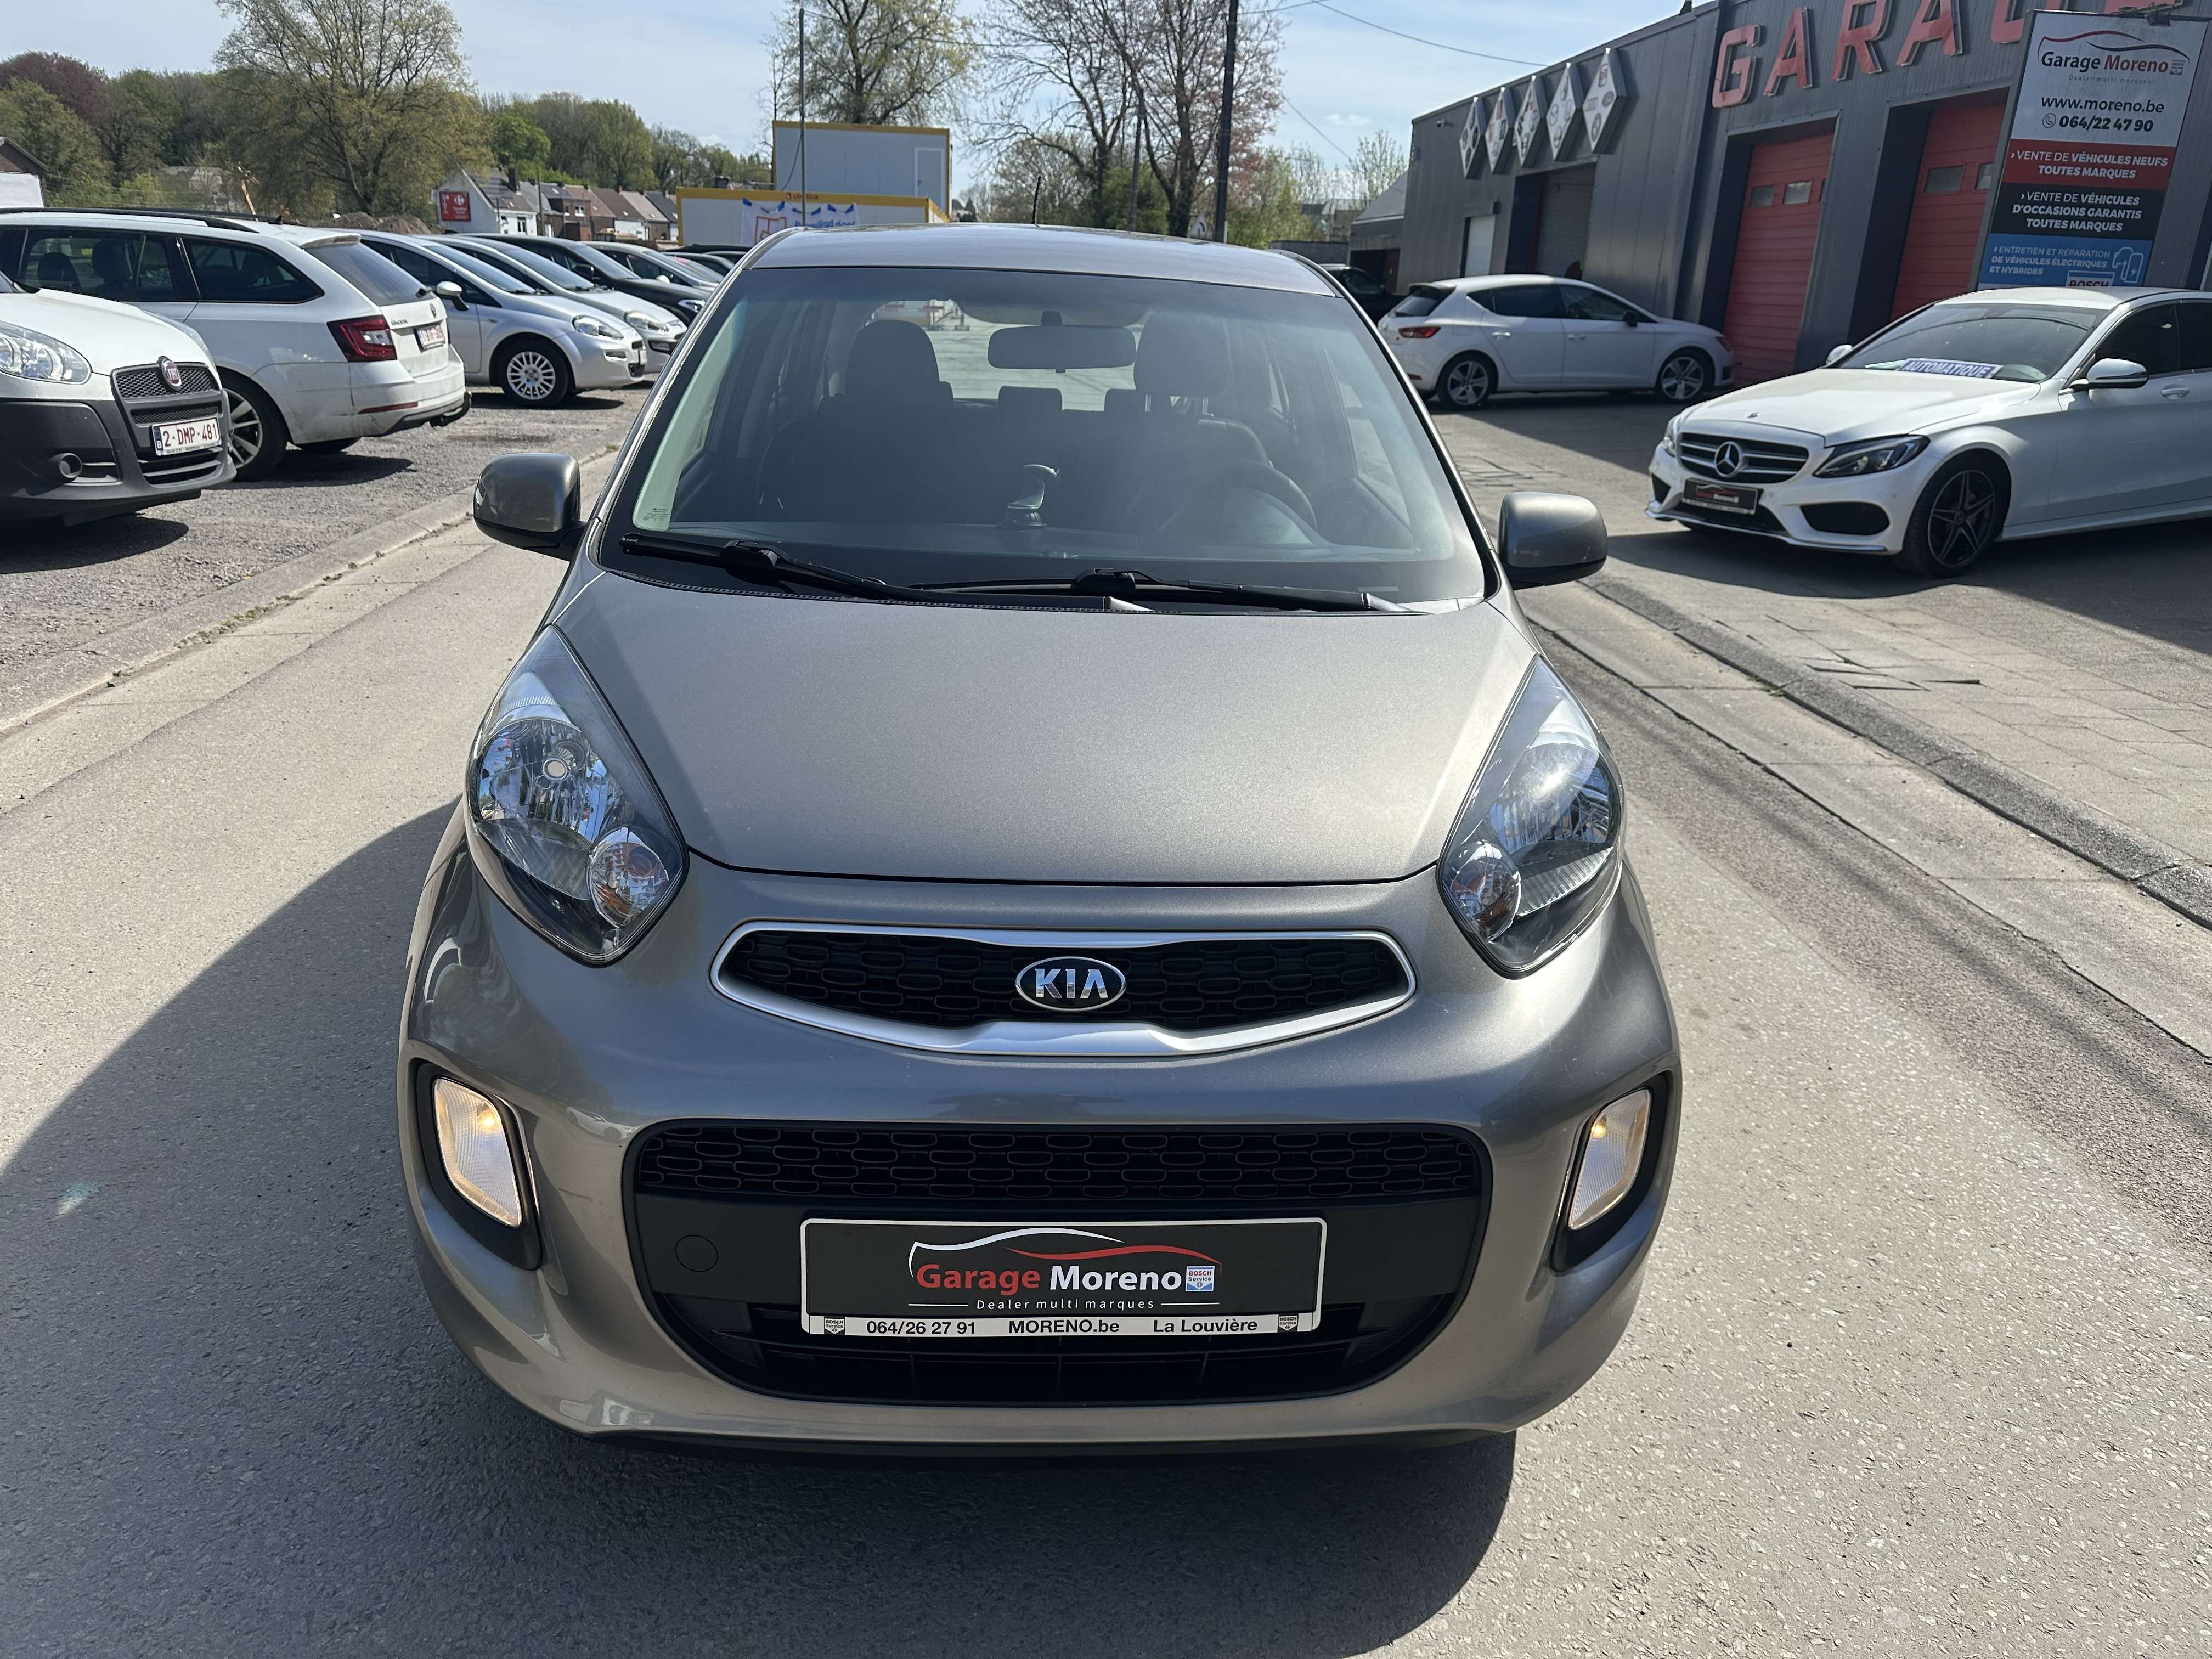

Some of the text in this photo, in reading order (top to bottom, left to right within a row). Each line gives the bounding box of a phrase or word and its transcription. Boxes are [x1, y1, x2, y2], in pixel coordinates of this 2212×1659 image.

[2041, 51, 2168, 73] Garage Moreno
[2041, 97, 2164, 113] www.moreno.be
[2059, 115, 2154, 132] 064/22 47 90
[2017, 150, 2168, 166] VENTE DE VÉHICULES NEUFS
[2039, 165, 2136, 179] TOUTES MARQUES
[2027, 191, 2140, 206] VENTE DE VÉHICULES
[2013, 204, 2142, 219] D'OCCASIONS GARANTIS
[2027, 218, 2124, 232] TOUTES MARQUES
[1999, 245, 2111, 258] ENTRETIEN ET RÉPARATION
[2005, 255, 2052, 265] VÉHICULES
[2051, 258, 2107, 268] ÉLECTRIQUES
[2001, 266, 2044, 275] HYBRIDES
[1904, 360, 1991, 377] AUTOMATIQUE
[1035, 968, 1108, 998] KIA
[916, 1263, 1182, 1295] Garage Moreno
[977, 1299, 1154, 1311] Dealer multi marques
[867, 1318, 1258, 1335] 064/26 27 91 MORENO.be La Louvière
